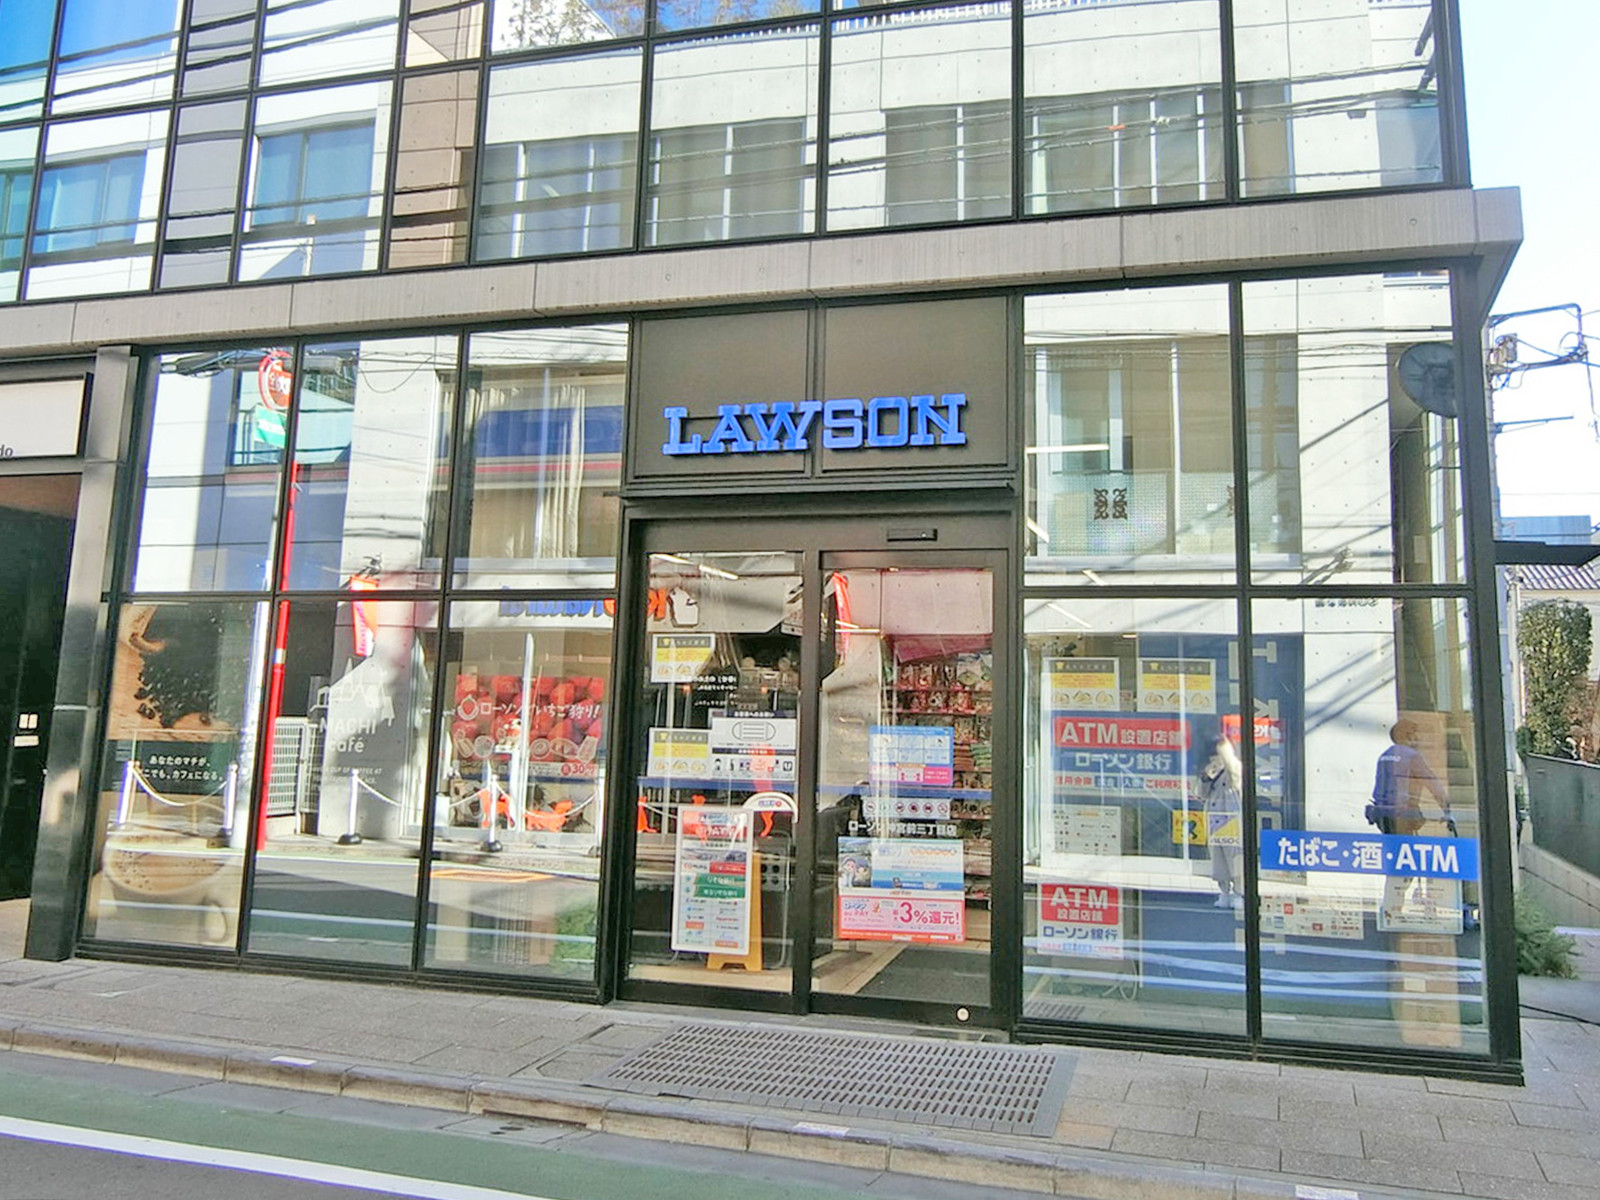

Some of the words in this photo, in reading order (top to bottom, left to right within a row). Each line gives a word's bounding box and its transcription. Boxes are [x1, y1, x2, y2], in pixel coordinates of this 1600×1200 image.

[662, 393, 967, 456] LAWSON
[480, 702, 601, 719] ローソンいちご狩り!
[319, 717, 377, 734] MACHI
[329, 736, 365, 753] café
[1074, 751, 1173, 771] ローソン銀行
[139, 769, 224, 782] こでも、カフェになる。
[1278, 837, 1460, 873] たばこ・酒・ATM
[1050, 886, 1108, 909] ATM
[1057, 909, 1103, 922] 設置店舗
[1043, 926, 1118, 941] ローソン銀行
